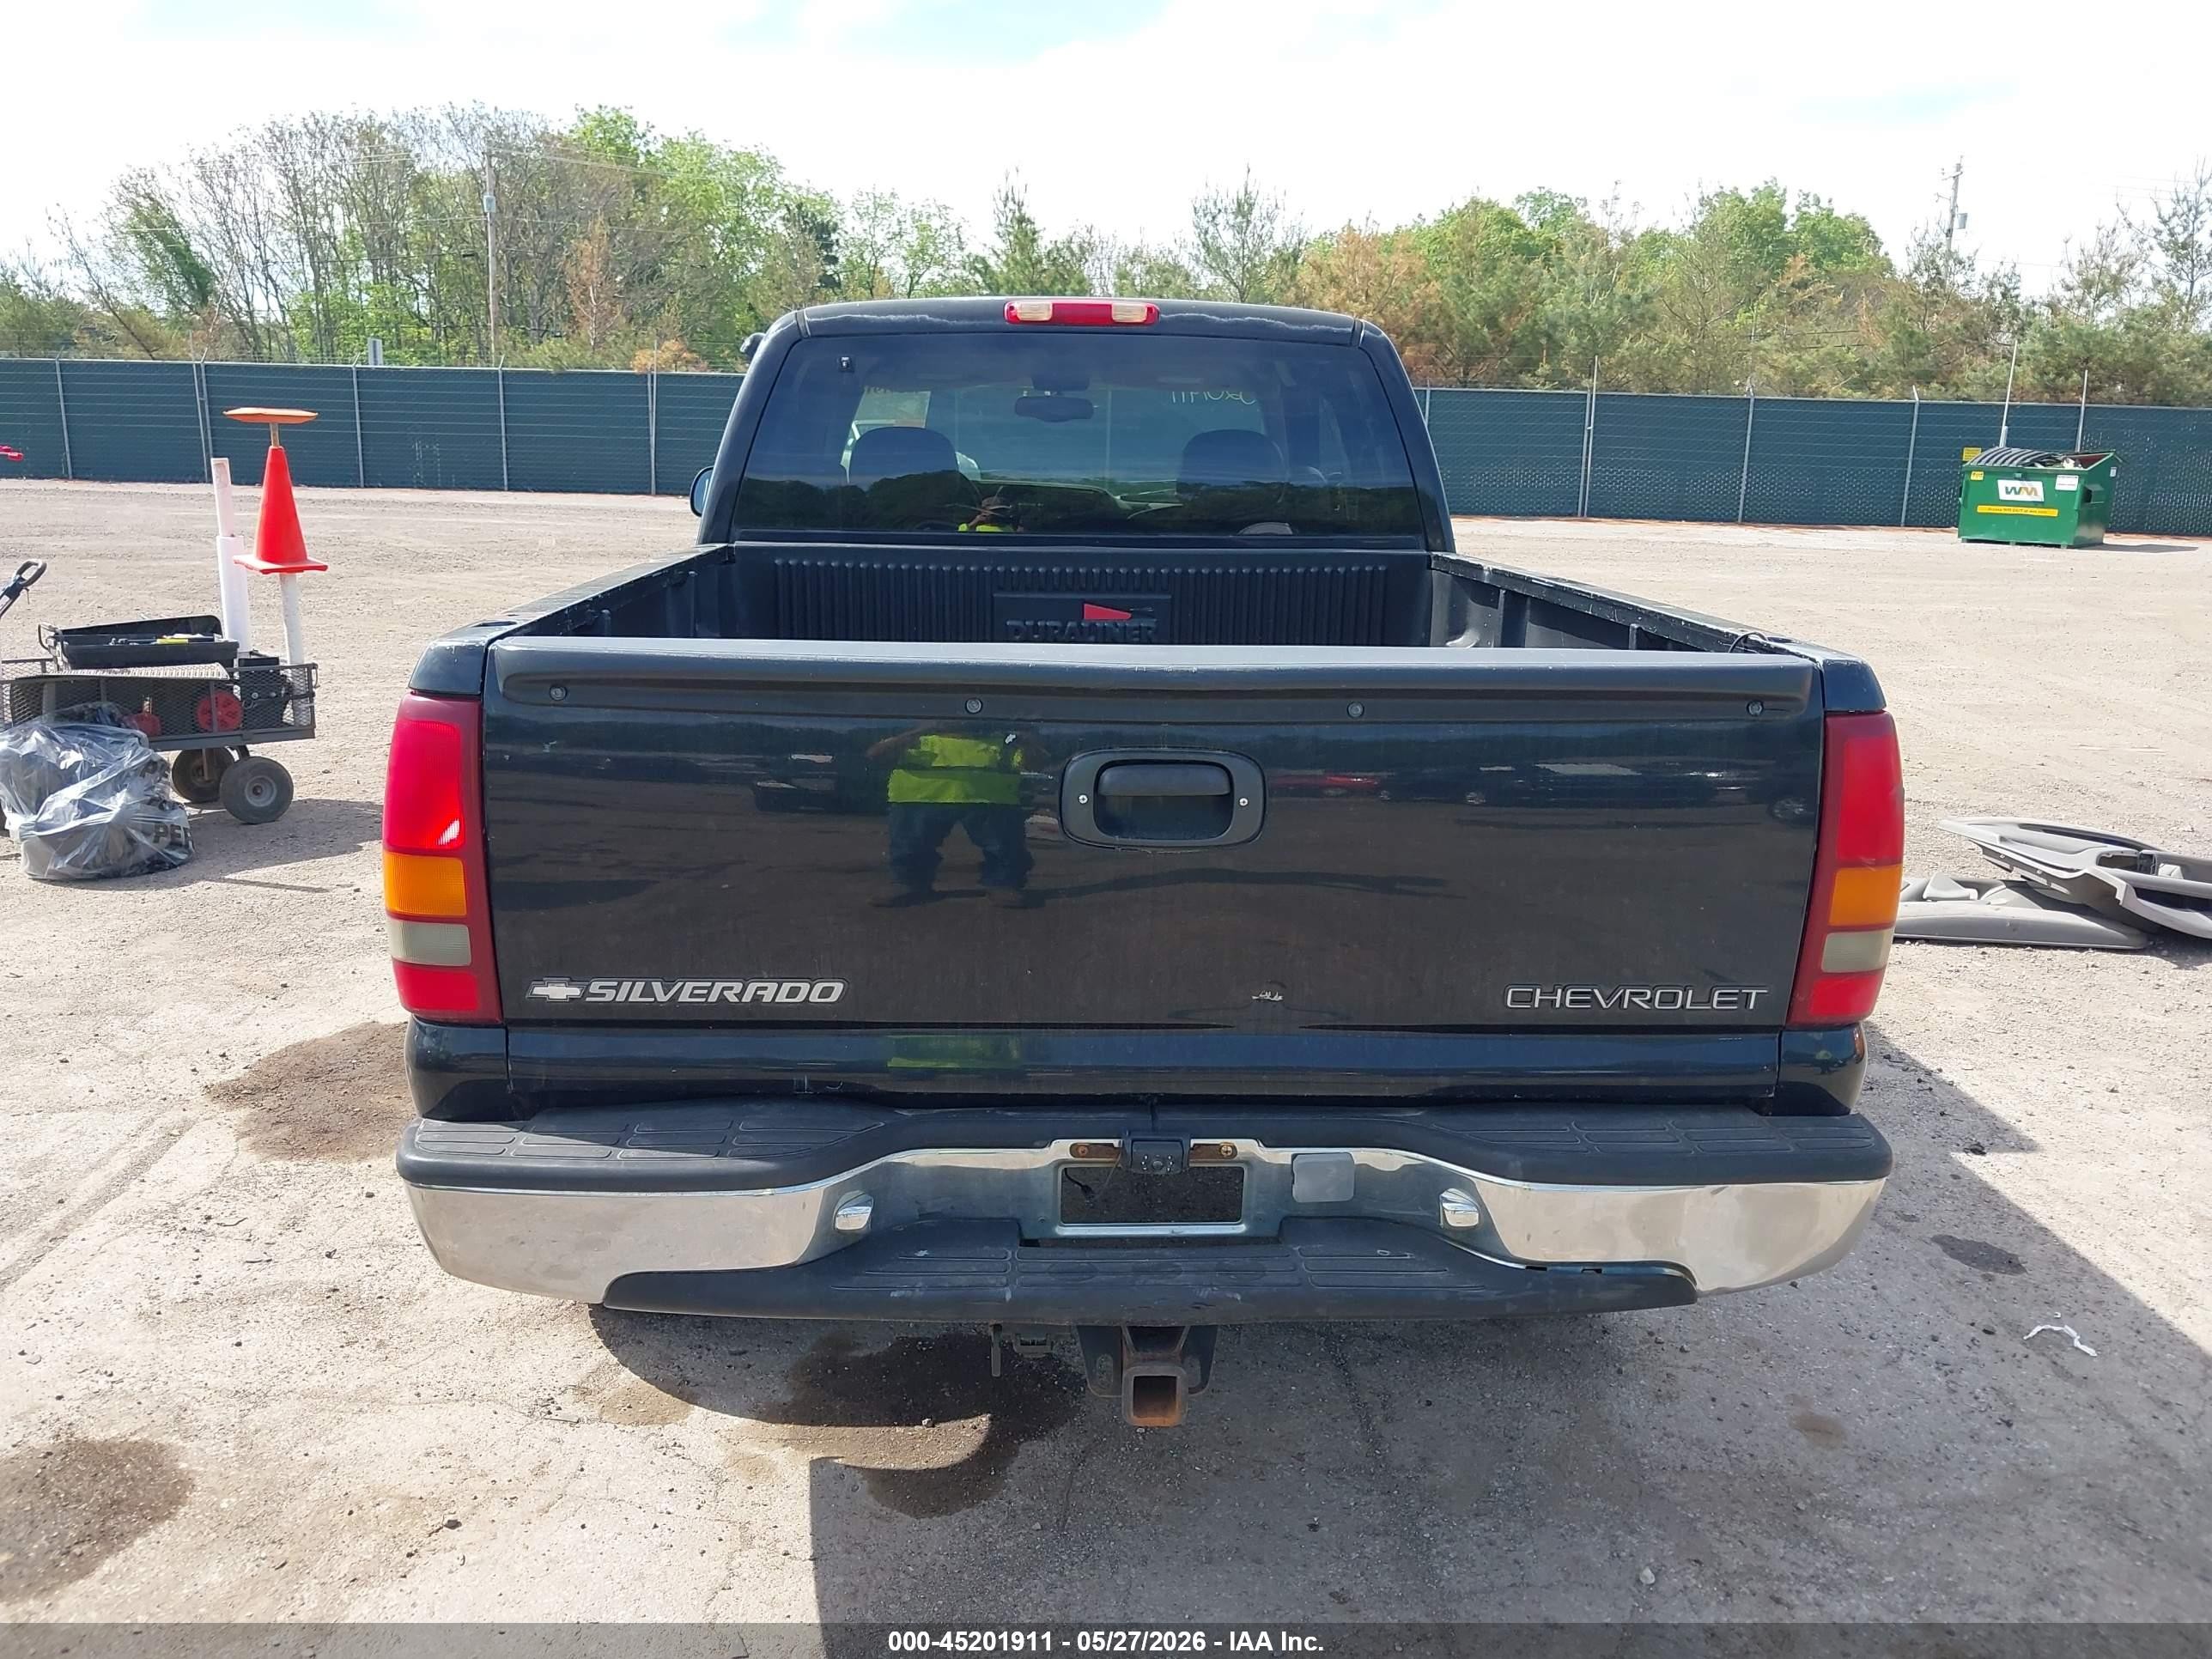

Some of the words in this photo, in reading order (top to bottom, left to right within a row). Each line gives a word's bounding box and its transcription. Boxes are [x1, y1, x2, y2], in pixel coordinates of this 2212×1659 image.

[2004, 486, 2039, 496] WM
[1006, 620, 1158, 642] DURALINER
[586, 981, 846, 1003] SILVERADO
[1506, 988, 1768, 1010] CHEVROLET
